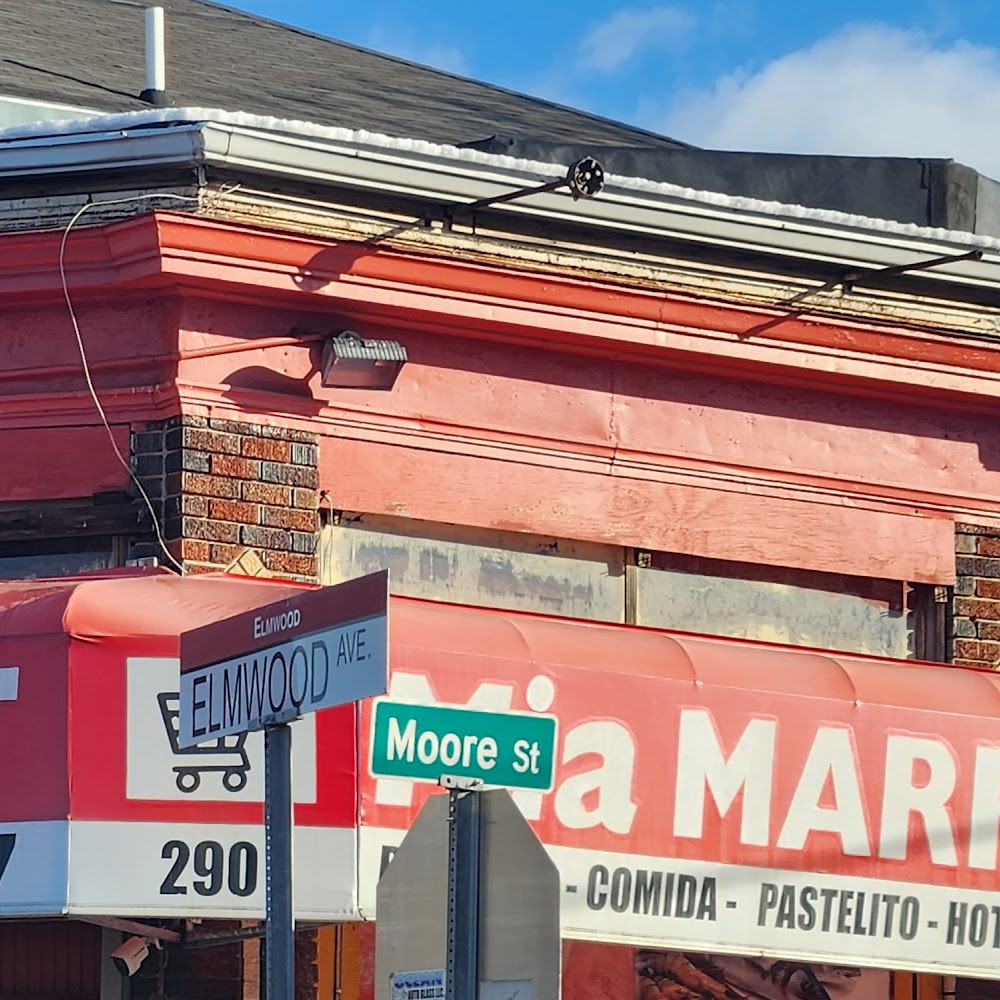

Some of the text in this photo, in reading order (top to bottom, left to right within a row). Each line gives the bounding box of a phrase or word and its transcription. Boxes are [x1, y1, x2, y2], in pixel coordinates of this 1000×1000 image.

[192, 628, 372, 737] ELMWOOD AVE.
[387, 717, 540, 774] Moore St
[160, 840, 258, 897] 290
[587, 864, 717, 921] COMIDA
[757, 883, 919, 940] PASTELITO
